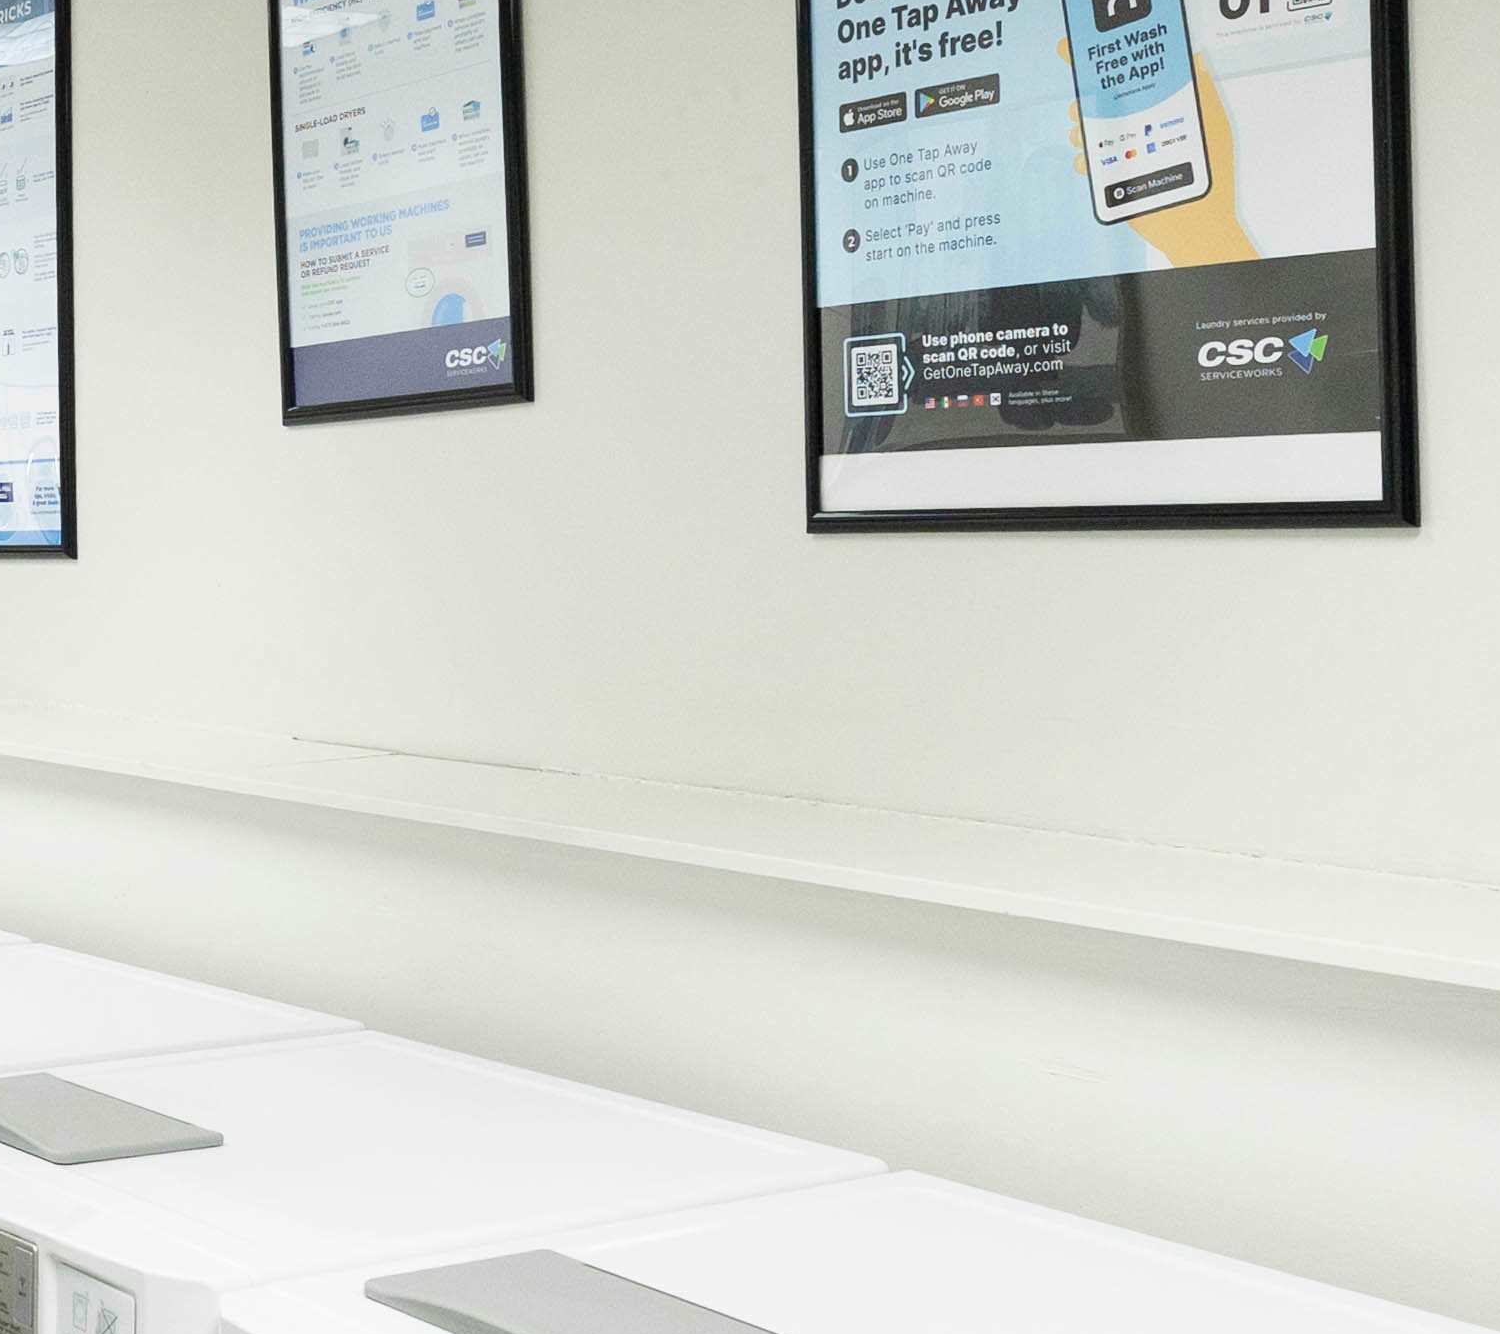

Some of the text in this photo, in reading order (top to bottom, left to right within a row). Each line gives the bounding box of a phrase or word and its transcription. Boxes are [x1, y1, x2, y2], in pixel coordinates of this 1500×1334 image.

[838, 15, 885, 44] One
[891, 6, 938, 32] Tap
[839, 20, 1002, 83] app, it's free!
[1088, 24, 1168, 61] First Wash
[1096, 42, 1165, 75] Free with
[1101, 59, 1165, 90] the App!
[939, 89, 995, 107] Google Play
[294, 105, 365, 133] SINGLE-LOAD DRYERS
[857, 106, 902, 124] App Store
[864, 140, 977, 171] Use One Tap Away
[864, 158, 992, 192] app to scan QR code
[1126, 173, 1183, 195] Scan Machine
[865, 189, 936, 209] on machine.
[299, 198, 449, 239] PROVIDING WORKING MACHINES
[865, 227, 902, 243] Select
[937, 218, 961, 232] and
[965, 213, 1001, 229] press
[299, 224, 392, 252] IS IMPORTANT TO US
[866, 234, 997, 262] start on the machine.
[300, 244, 389, 269] HOW TO SUBMIT SERVICE
[300, 258, 370, 278] OR REFUND REQUEST
[922, 323, 1068, 347] Use phone camera to
[1196, 312, 1327, 330] Laundry services provided by
[445, 345, 487, 368] CSC
[923, 339, 1071, 363] scan QR code, or visit
[1198, 337, 1284, 367] CSC
[923, 359, 1063, 380] GetOneTapAway.com
[1201, 368, 1283, 381] SERVICEWORKS
